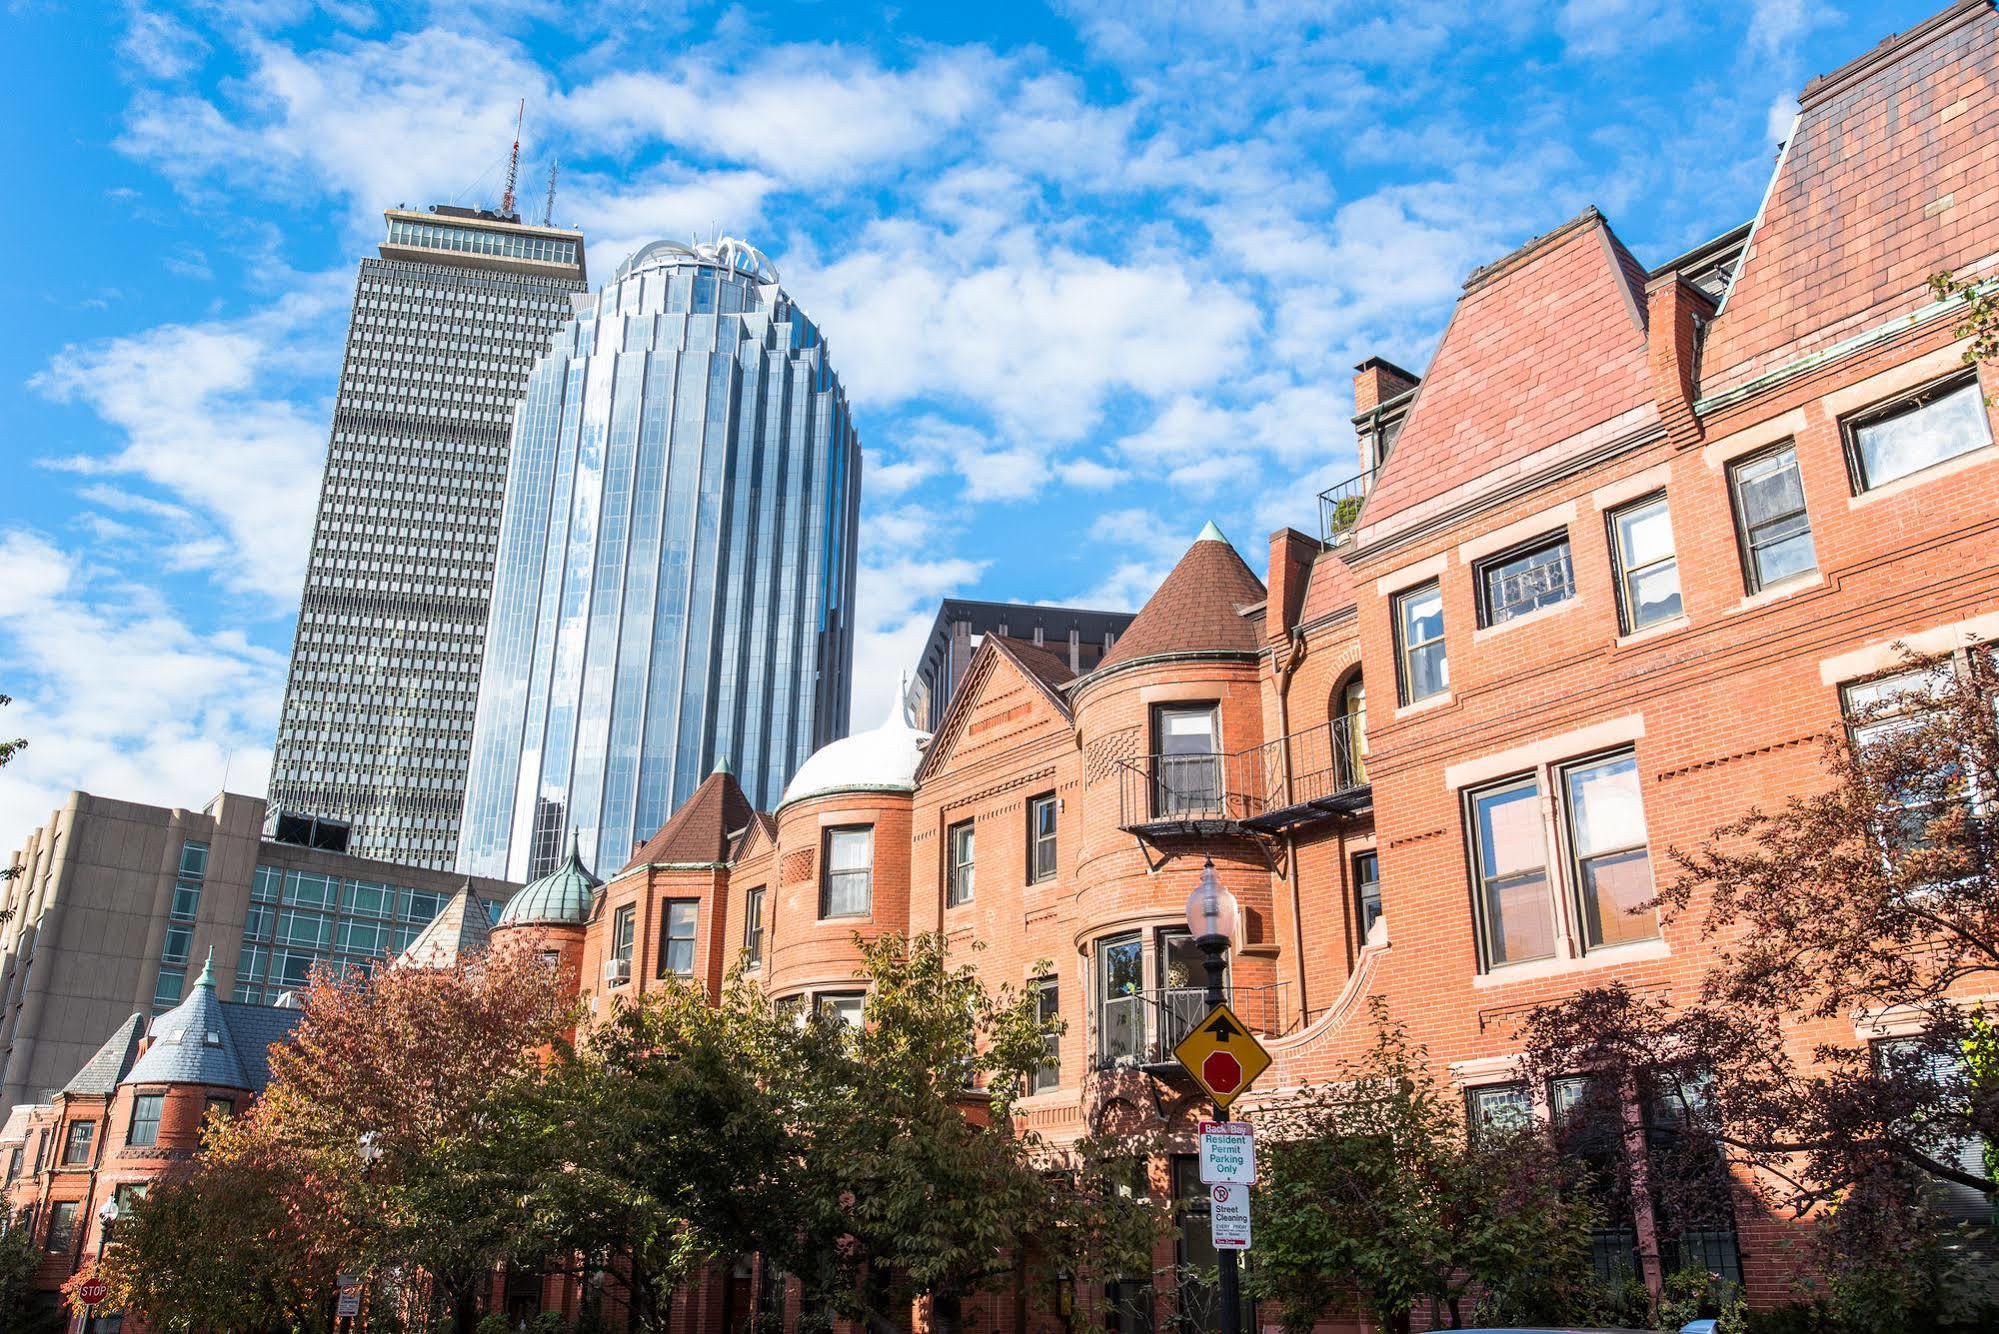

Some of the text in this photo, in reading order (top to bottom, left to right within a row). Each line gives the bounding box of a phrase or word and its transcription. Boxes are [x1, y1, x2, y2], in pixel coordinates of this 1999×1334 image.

[1205, 1124, 1246, 1135] Back Bay
[1206, 1135, 1245, 1144] Resident
[1212, 1144, 1241, 1153] Permit
[1210, 1154, 1243, 1165] Parking
[1217, 1164, 1238, 1175] Only
[1216, 1205, 1239, 1213] Street
[1216, 1213, 1248, 1224] Cleaning
[81, 1286, 107, 1296] STOP
